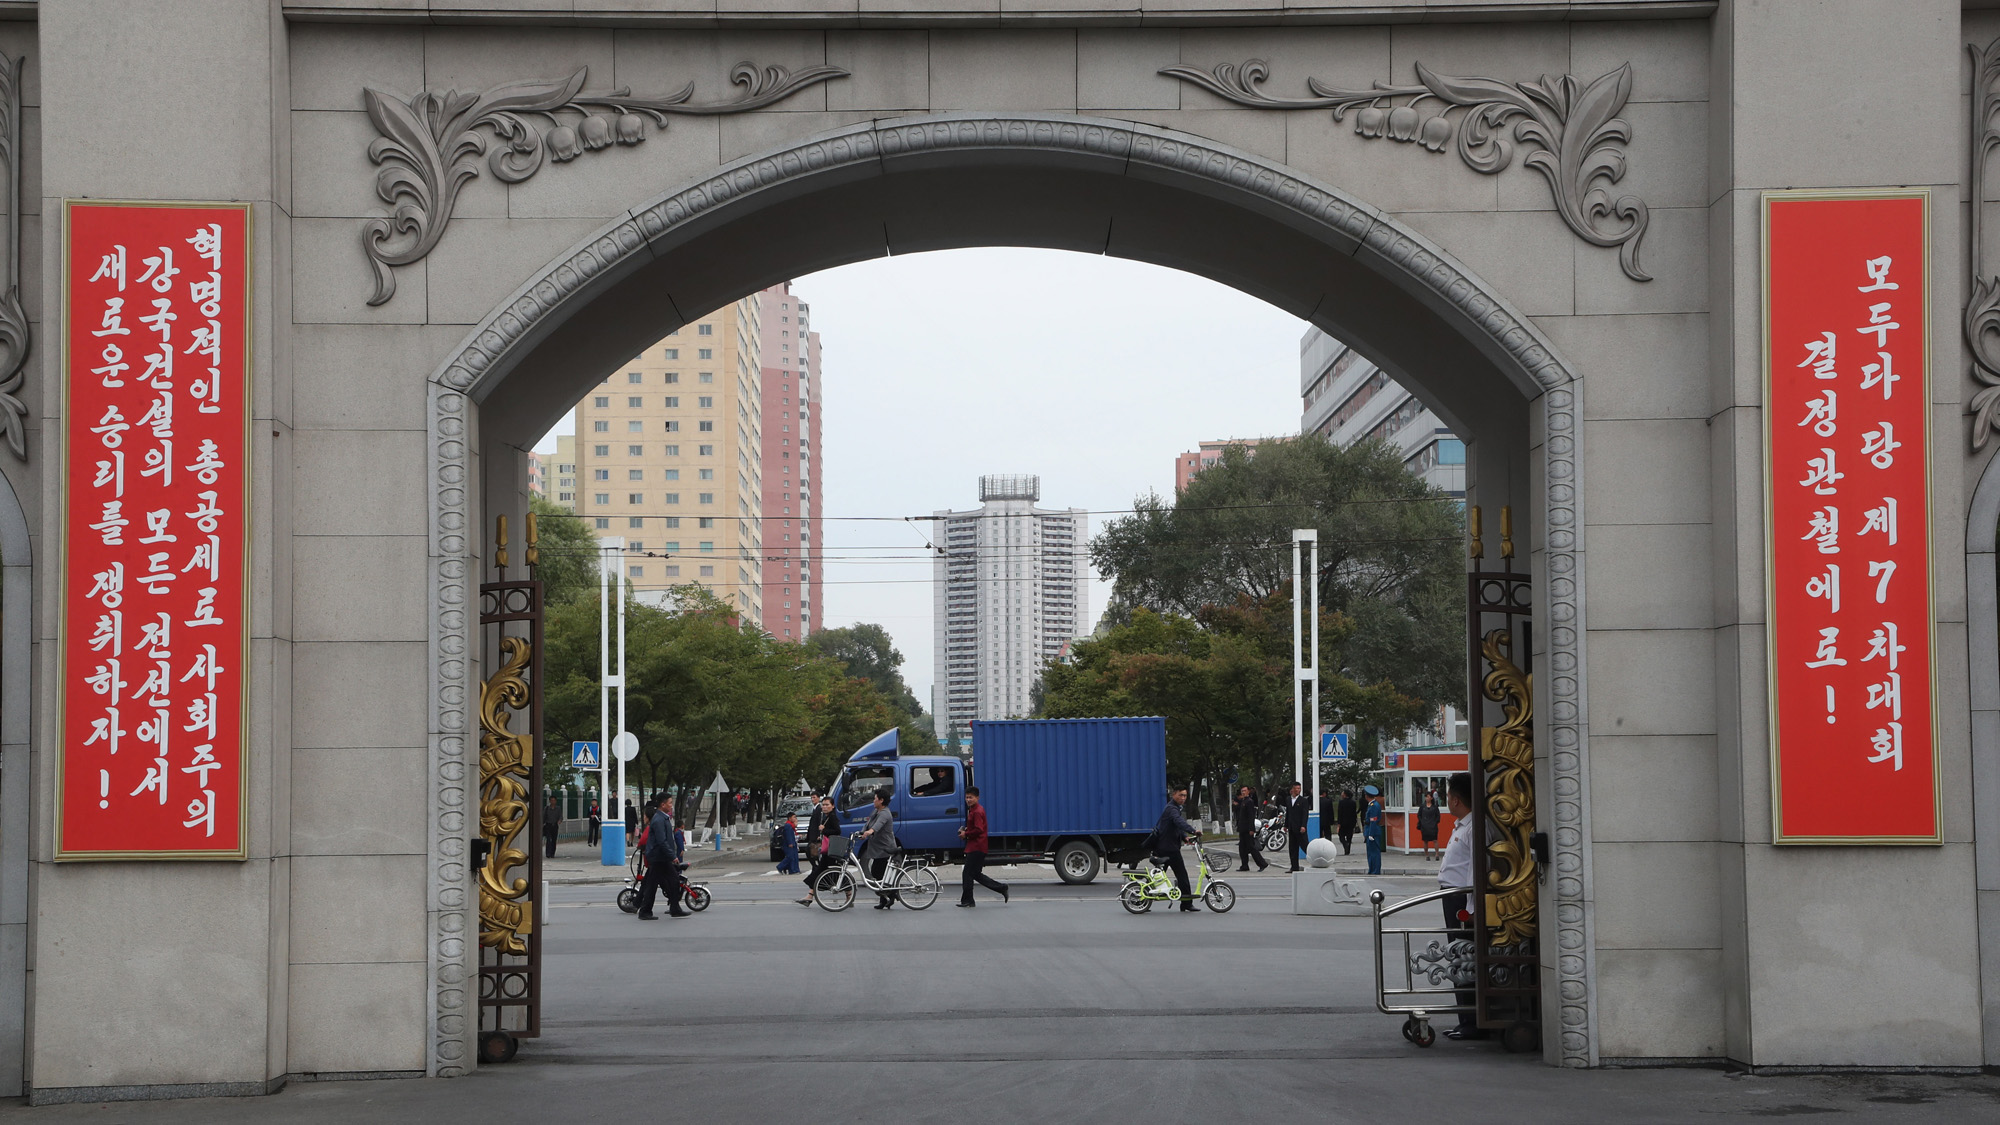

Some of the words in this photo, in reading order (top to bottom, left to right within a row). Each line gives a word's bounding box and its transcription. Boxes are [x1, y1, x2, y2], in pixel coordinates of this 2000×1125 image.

[88, 244, 131, 388] 새로운
[135, 246, 181, 488] 강국건설의
[183, 223, 222, 414] 혁명적인
[1856, 255, 1901, 401] 모두다
[88, 404, 131, 546] 승리를
[1860, 421, 1902, 470] 당
[136, 508, 178, 595] 모든
[181, 434, 225, 628] 총공세로
[130, 611, 172, 806] 전선에서
[179, 643, 225, 838] 사회주의
